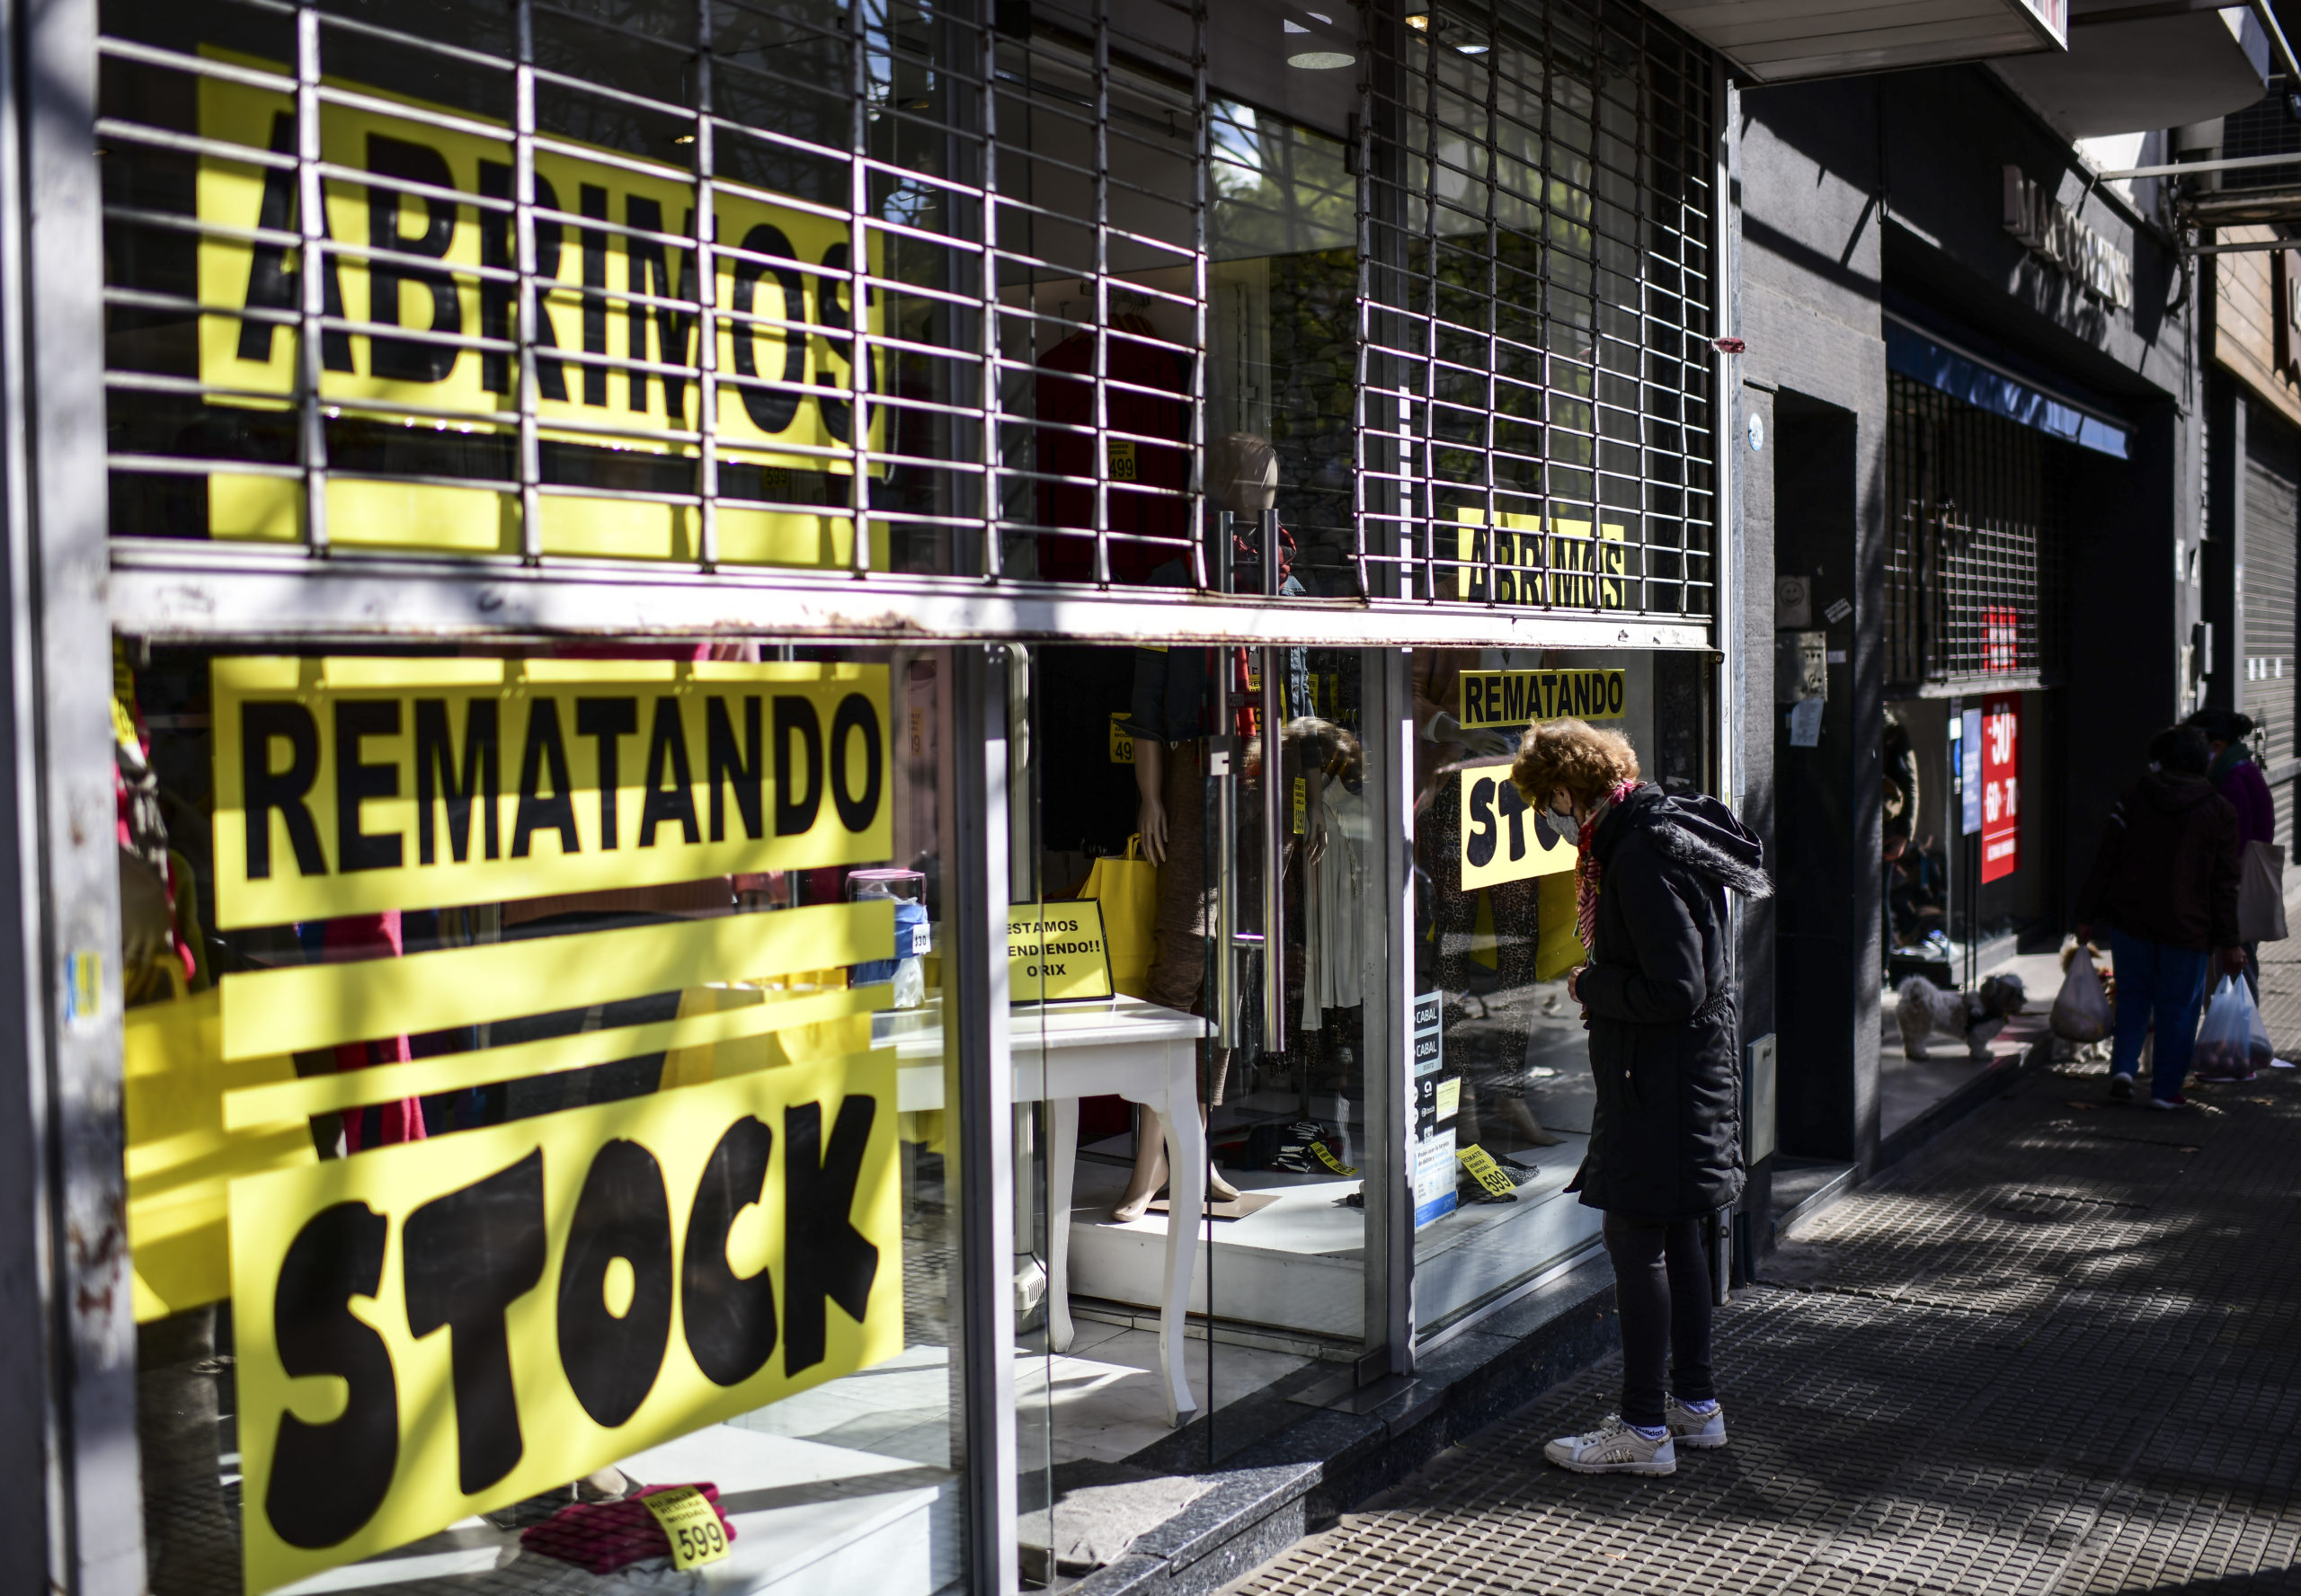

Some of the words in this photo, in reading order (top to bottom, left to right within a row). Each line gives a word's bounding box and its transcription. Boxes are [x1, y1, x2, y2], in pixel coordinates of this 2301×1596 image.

[236, 110, 875, 446] ABRIMOS
[1110, 458, 1133, 477] 499
[1465, 671, 1623, 724] REMATANDO
[1115, 741, 1133, 760] 49
[241, 692, 883, 881] REMATANDO
[1007, 919, 1079, 935] ESTAMOS
[915, 935, 927, 947] $30
[1008, 940, 1101, 957] ENDIENDO!!
[1026, 964, 1067, 978] ORIX
[1417, 1007, 1437, 1024] CABAL
[1417, 1041, 1437, 1058] CABAL
[1461, 1150, 1483, 1163] REMATE
[1482, 1170, 1511, 1193] 599
[264, 1094, 879, 1549] STOCK
[678, 1522, 724, 1561] 599
